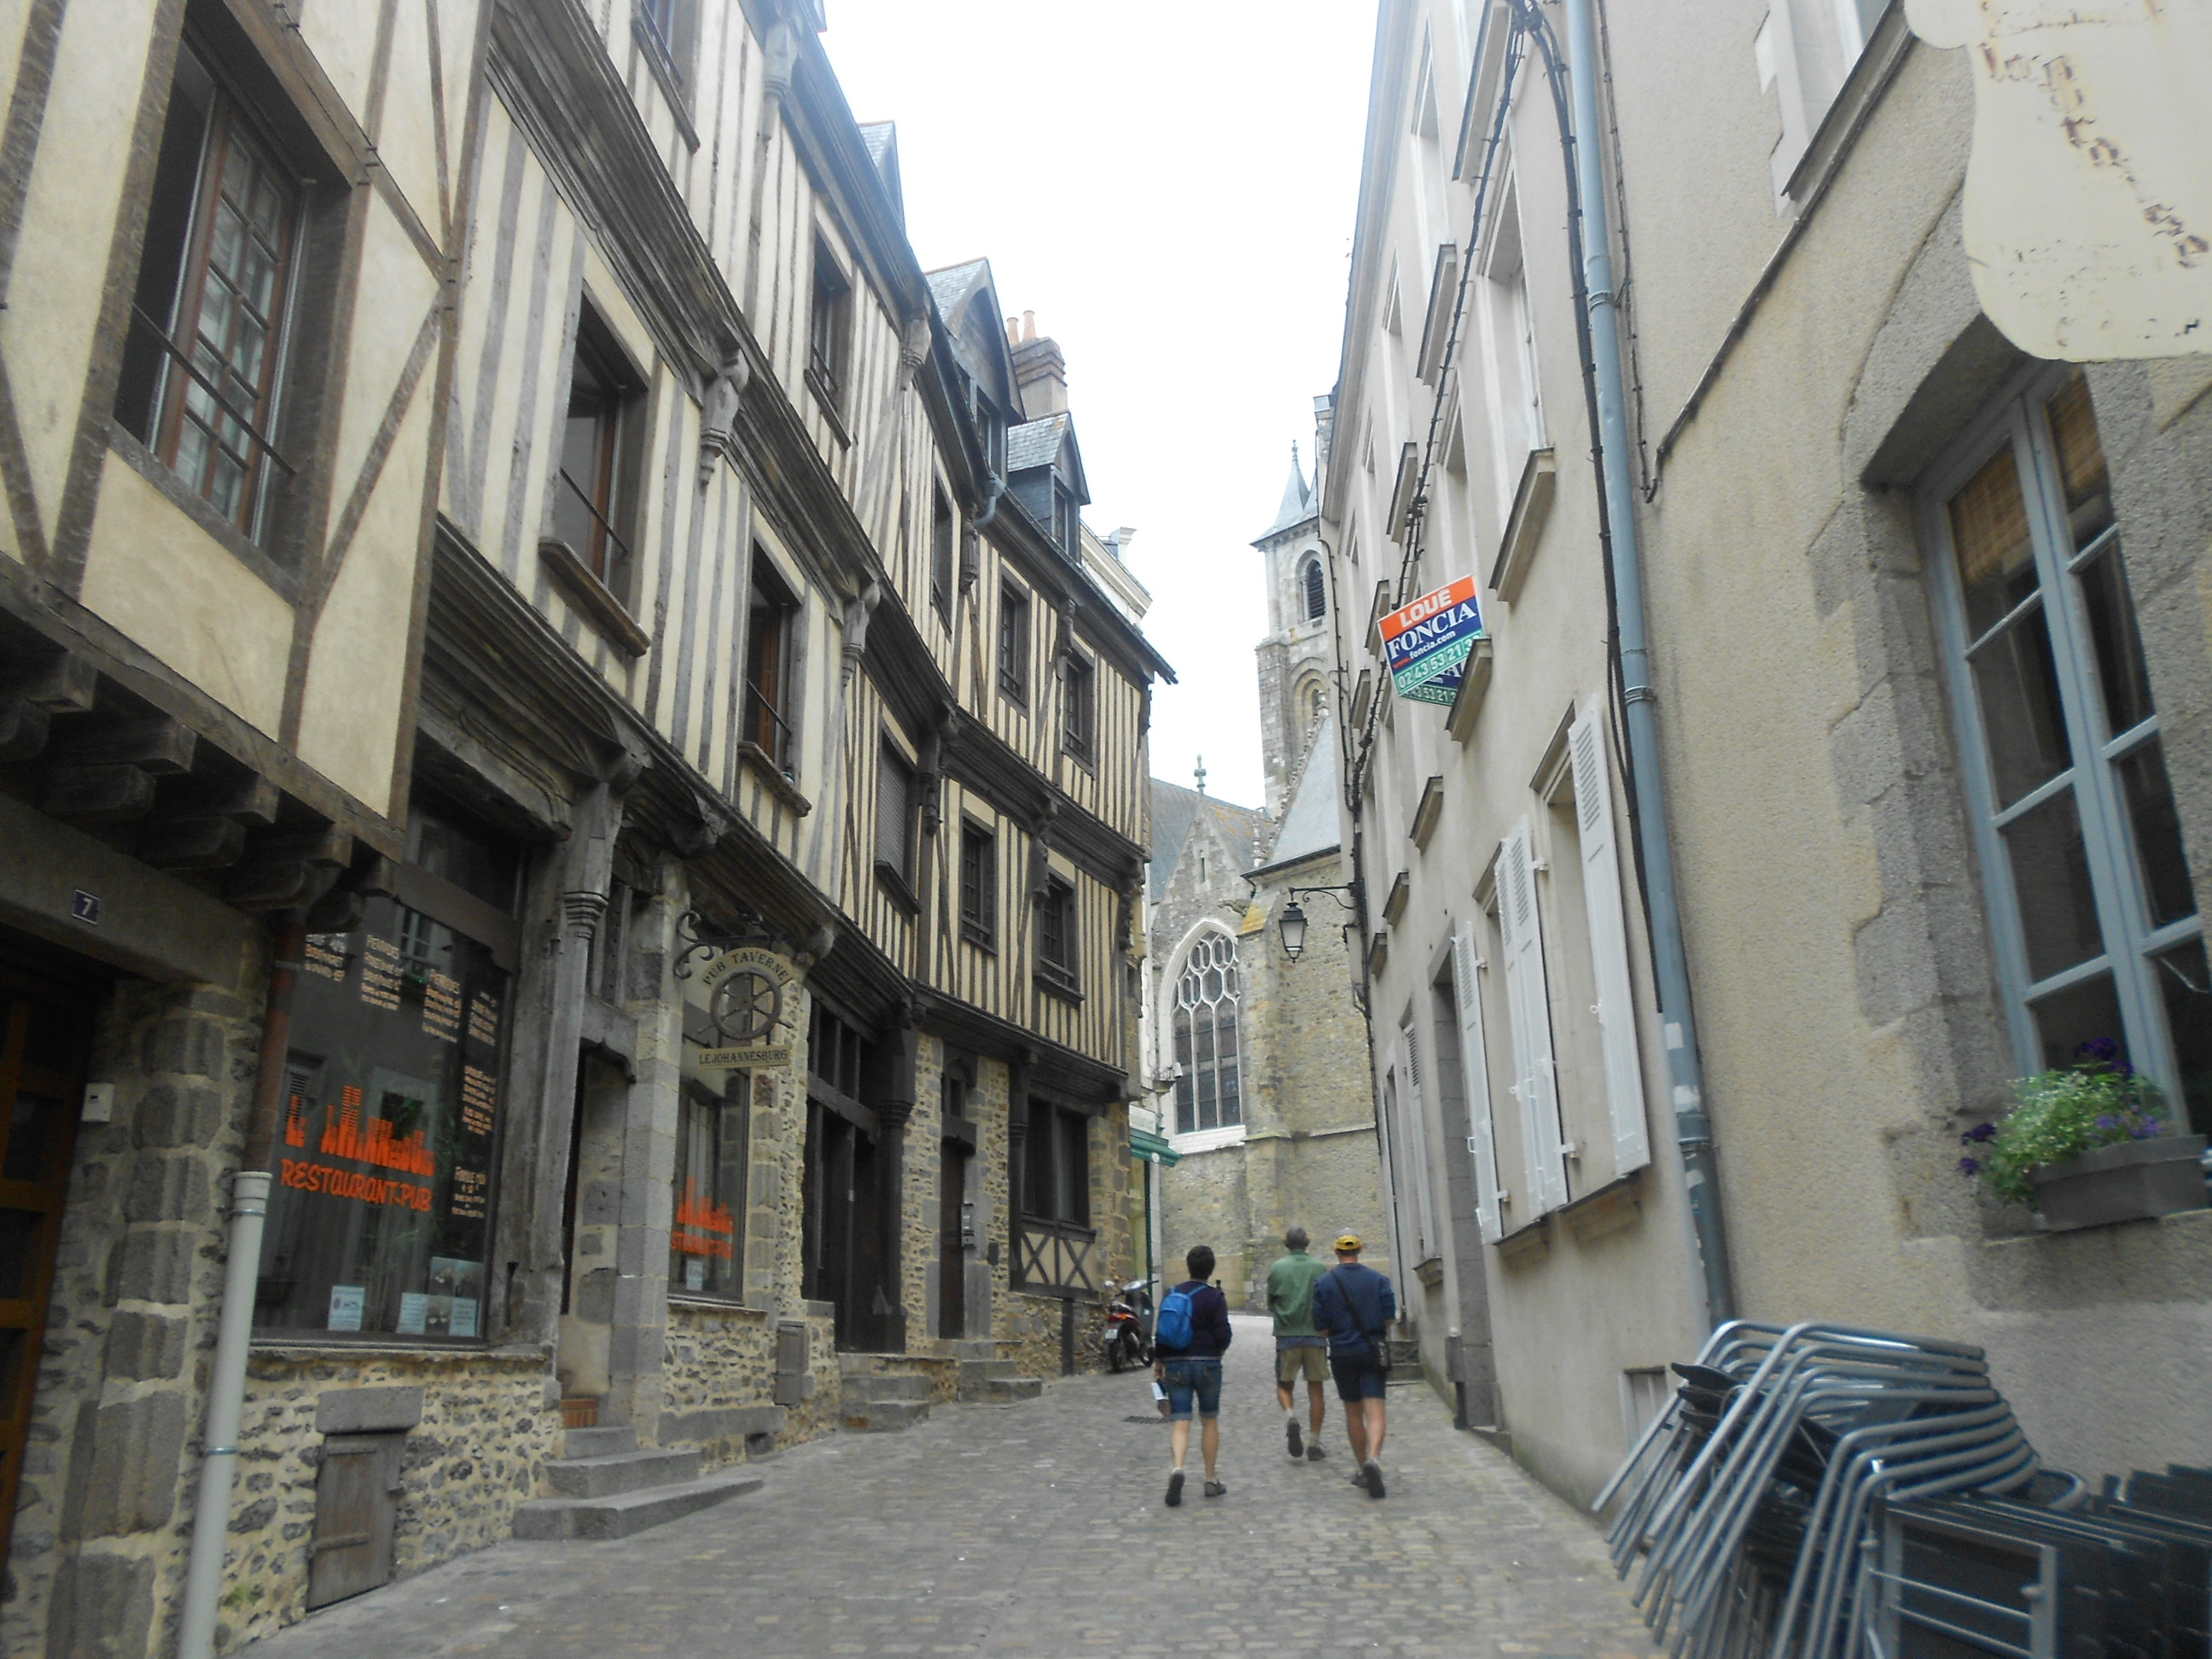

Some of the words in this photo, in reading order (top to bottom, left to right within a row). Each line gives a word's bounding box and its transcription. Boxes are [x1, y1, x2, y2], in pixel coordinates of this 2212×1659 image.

[1400, 589, 1452, 628] LOUE
[1387, 602, 1477, 660] FONCIA
[1399, 672, 1413, 689] 02
[1414, 661, 1429, 678] 43
[1430, 651, 1446, 670] 53
[1447, 644, 1462, 661] 21
[81, 897, 92, 916] 7
[702, 961, 726, 985] PUB
[731, 951, 789, 981] TAVERNE
